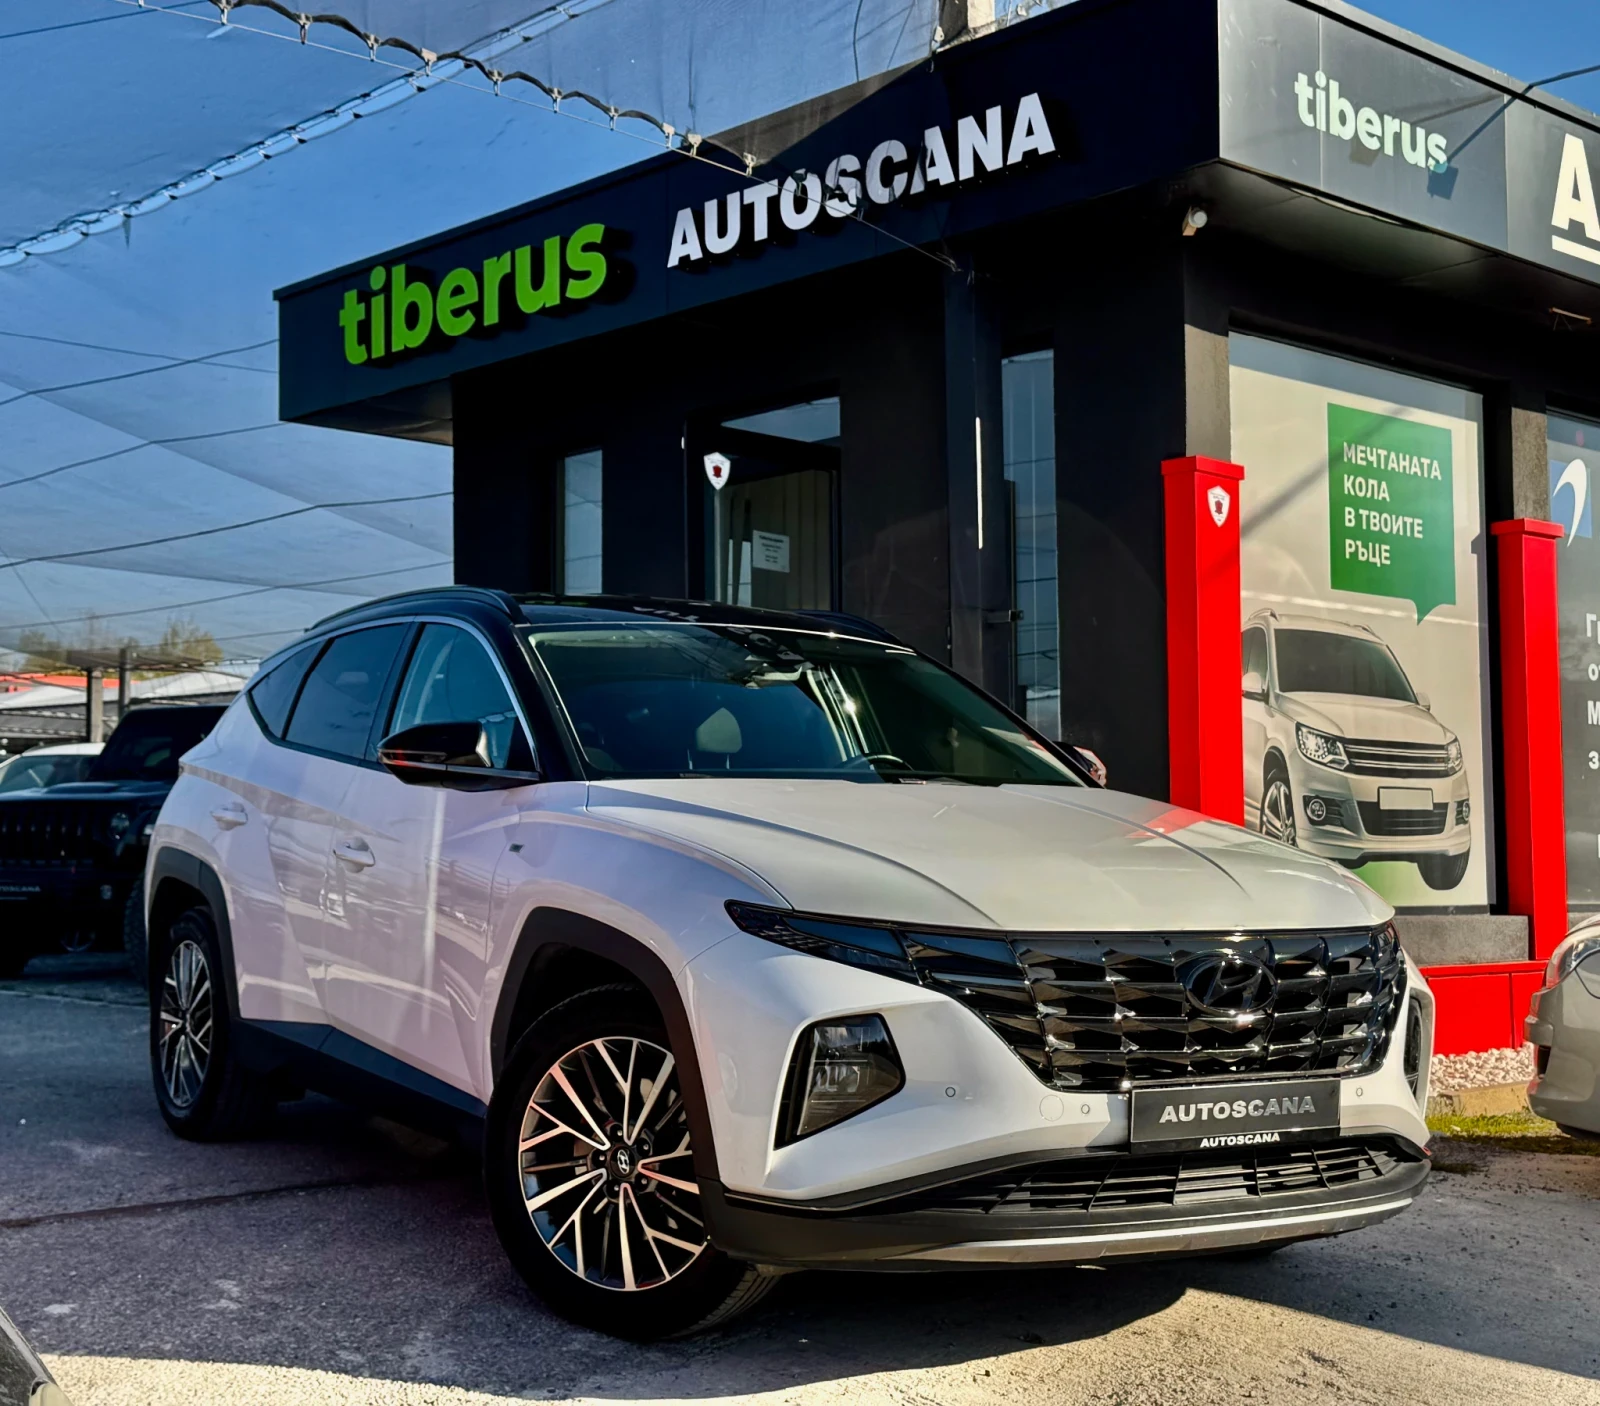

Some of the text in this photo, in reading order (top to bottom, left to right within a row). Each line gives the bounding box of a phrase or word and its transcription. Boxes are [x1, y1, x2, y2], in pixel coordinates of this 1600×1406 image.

[1294, 70, 1448, 173] tiberus
[667, 92, 1056, 268] AUTOSCANA
[339, 223, 607, 364] tiberus
[1343, 441, 1442, 481] МЕЧТАНАТА
[1343, 473, 1390, 502] КОЛА
[1344, 506, 1424, 539] В ТВОИТЕ
[1345, 538, 1391, 567] РЪЦЕ
[1159, 1095, 1316, 1124] AUTOSCANA
[1200, 1132, 1281, 1148] AUTOSCANA
